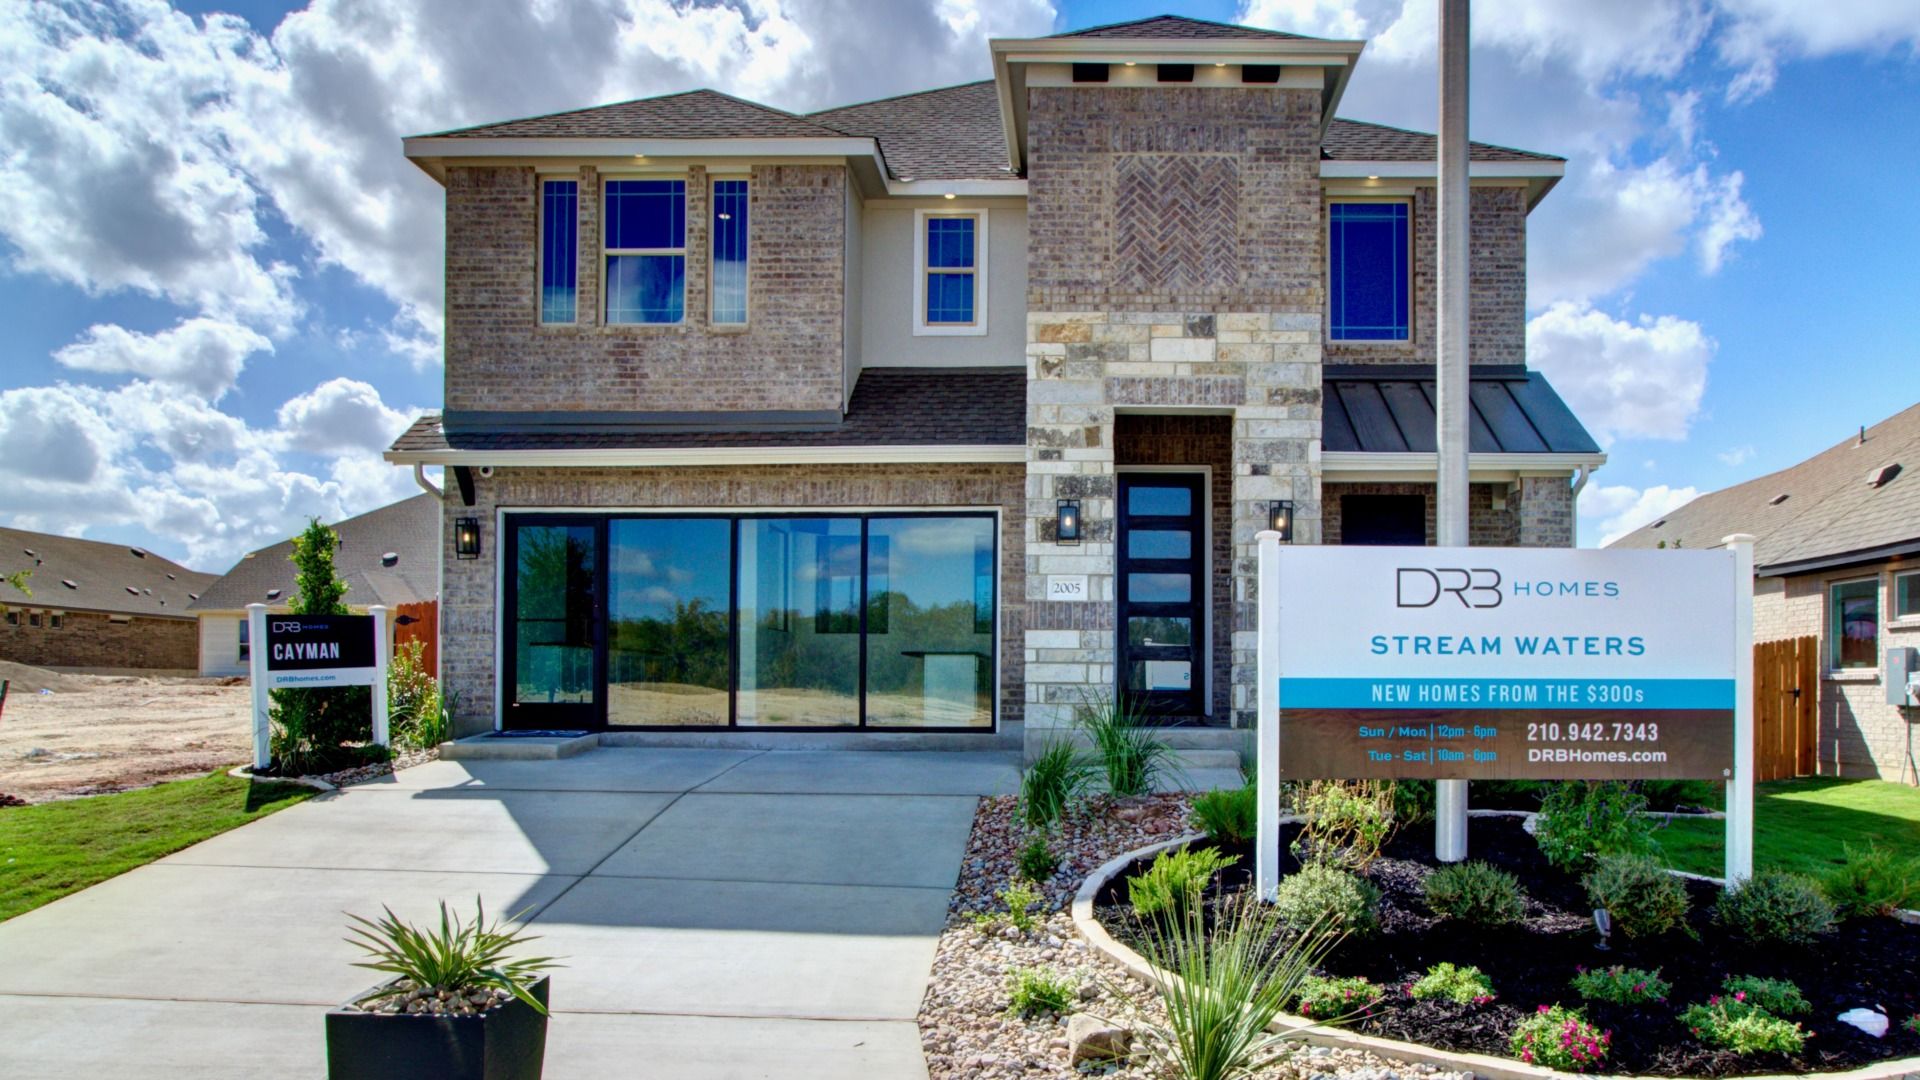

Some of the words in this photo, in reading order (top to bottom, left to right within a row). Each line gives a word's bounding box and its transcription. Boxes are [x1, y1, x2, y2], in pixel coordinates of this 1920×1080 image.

[1053, 582, 1081, 594] 2005
[1397, 568, 1502, 608] DRB
[1514, 581, 1620, 597] HOMES
[273, 621, 301, 633] DRB
[274, 642, 340, 660] CAYMAN
[1371, 636, 1501, 655] STREAM
[1515, 636, 1646, 656] WATERS
[1372, 684, 1411, 702] NEW
[1419, 684, 1480, 702] HOMES
[1489, 684, 1538, 702] FROM
[1545, 684, 1579, 702] THE
[1587, 684, 1644, 703] $300s
[1359, 726, 1385, 737] Sun
[1400, 726, 1427, 737] Mon
[1438, 725, 1465, 738] 12pm
[1473, 725, 1497, 739] 6pm
[1527, 723, 1658, 742] 210.942.7343
[1368, 750, 1392, 761] Tue
[1403, 750, 1427, 761] Sat
[1438, 749, 1465, 761] 10am
[1473, 749, 1497, 763] 6pm
[1528, 749, 1668, 762] DRBHomes.com
